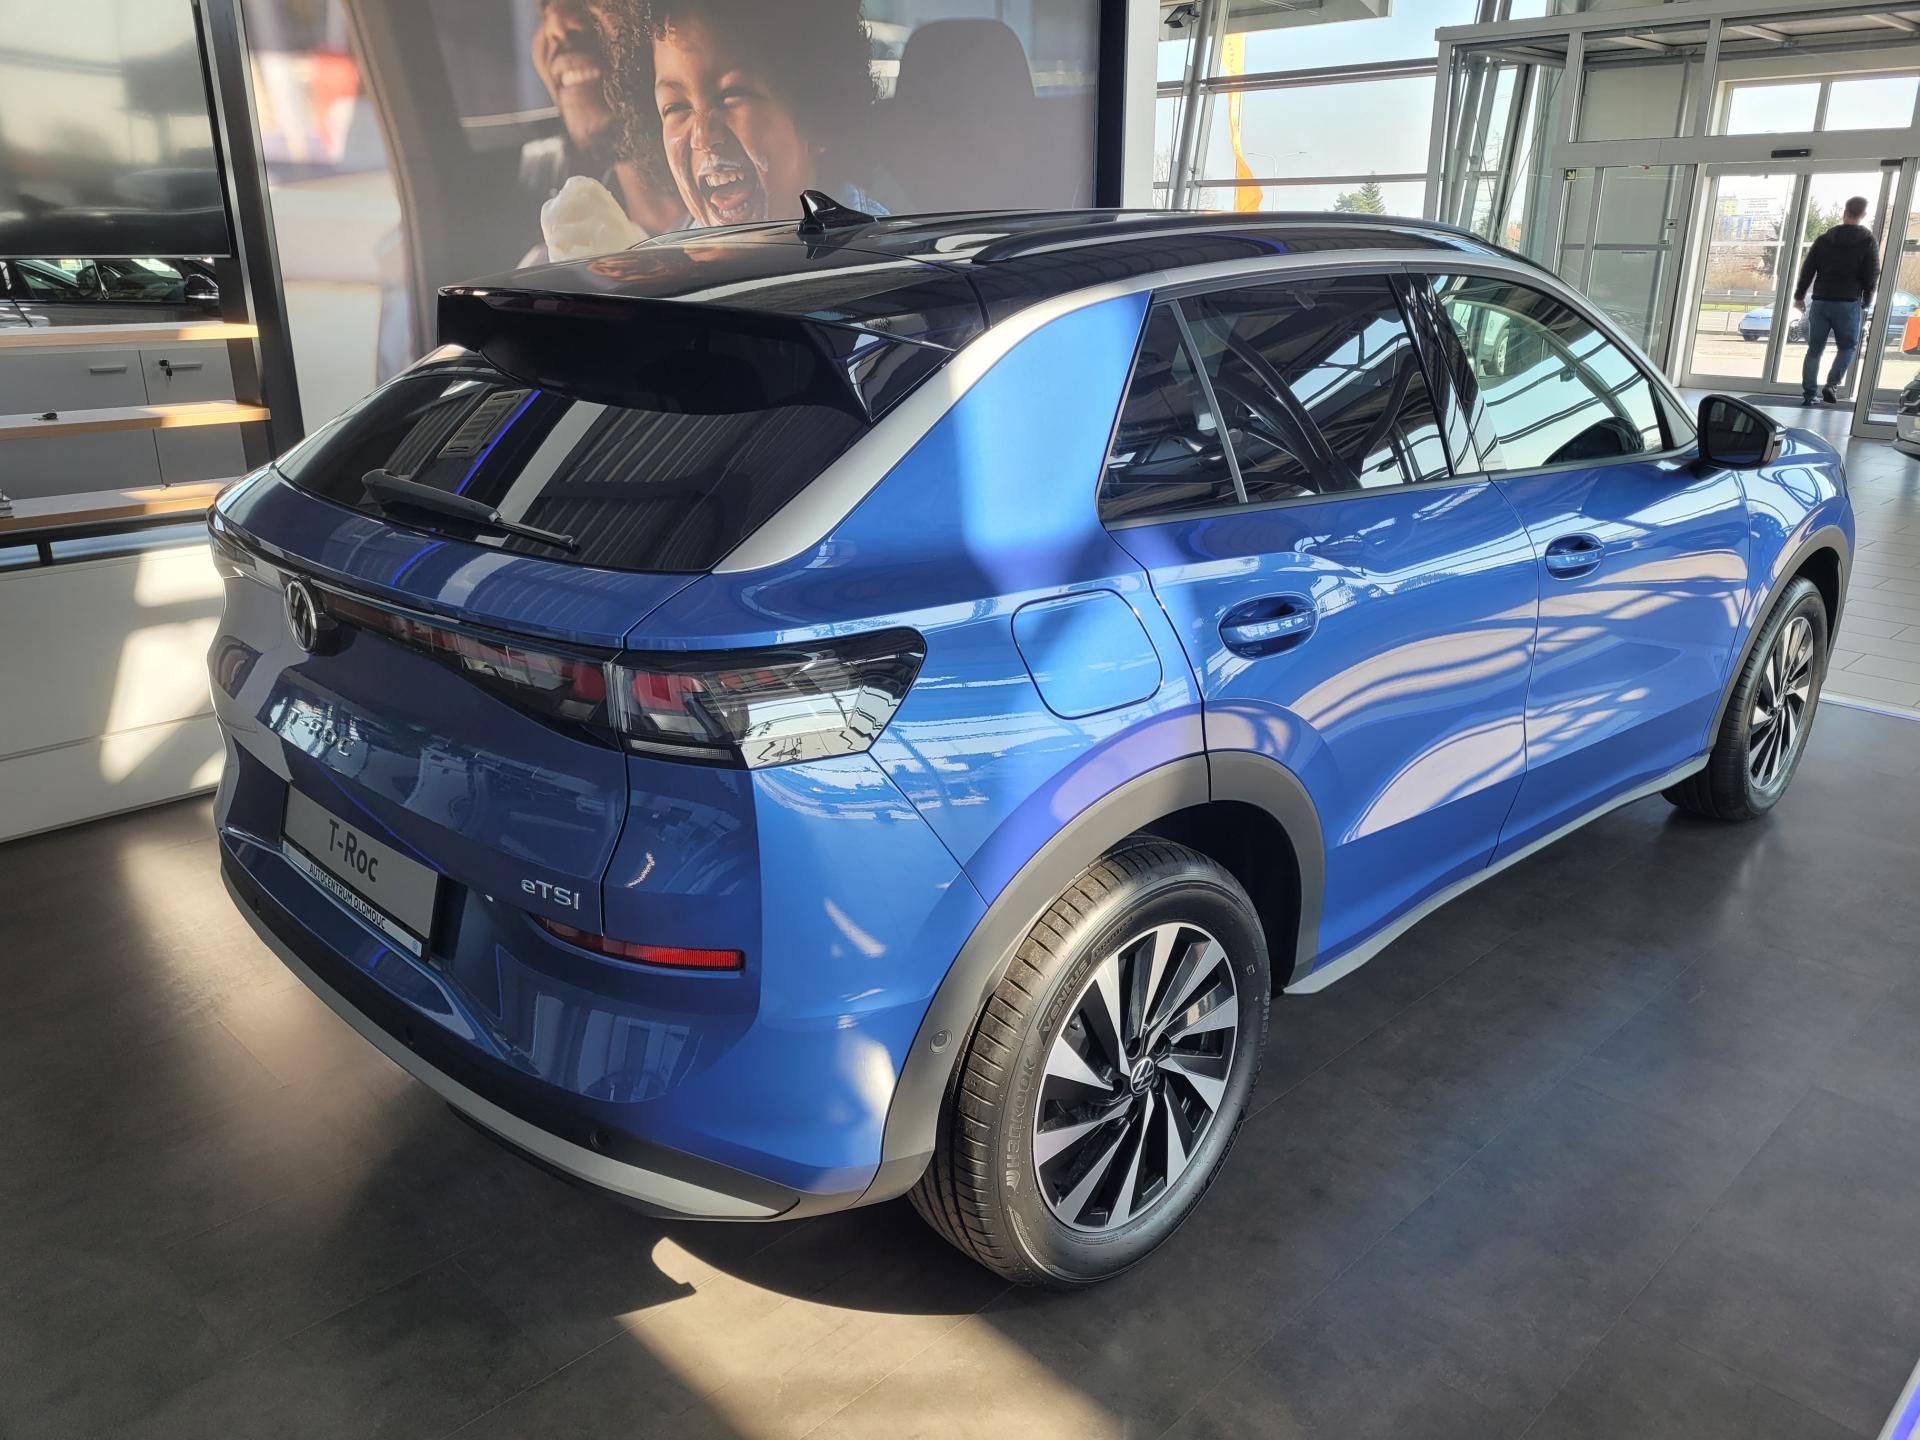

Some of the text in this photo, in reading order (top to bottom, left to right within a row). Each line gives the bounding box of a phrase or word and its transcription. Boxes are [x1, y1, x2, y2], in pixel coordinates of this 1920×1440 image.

[309, 863, 386, 930] AUTOCENTRUM OLOMOUC
[520, 879, 580, 911] eTSI
